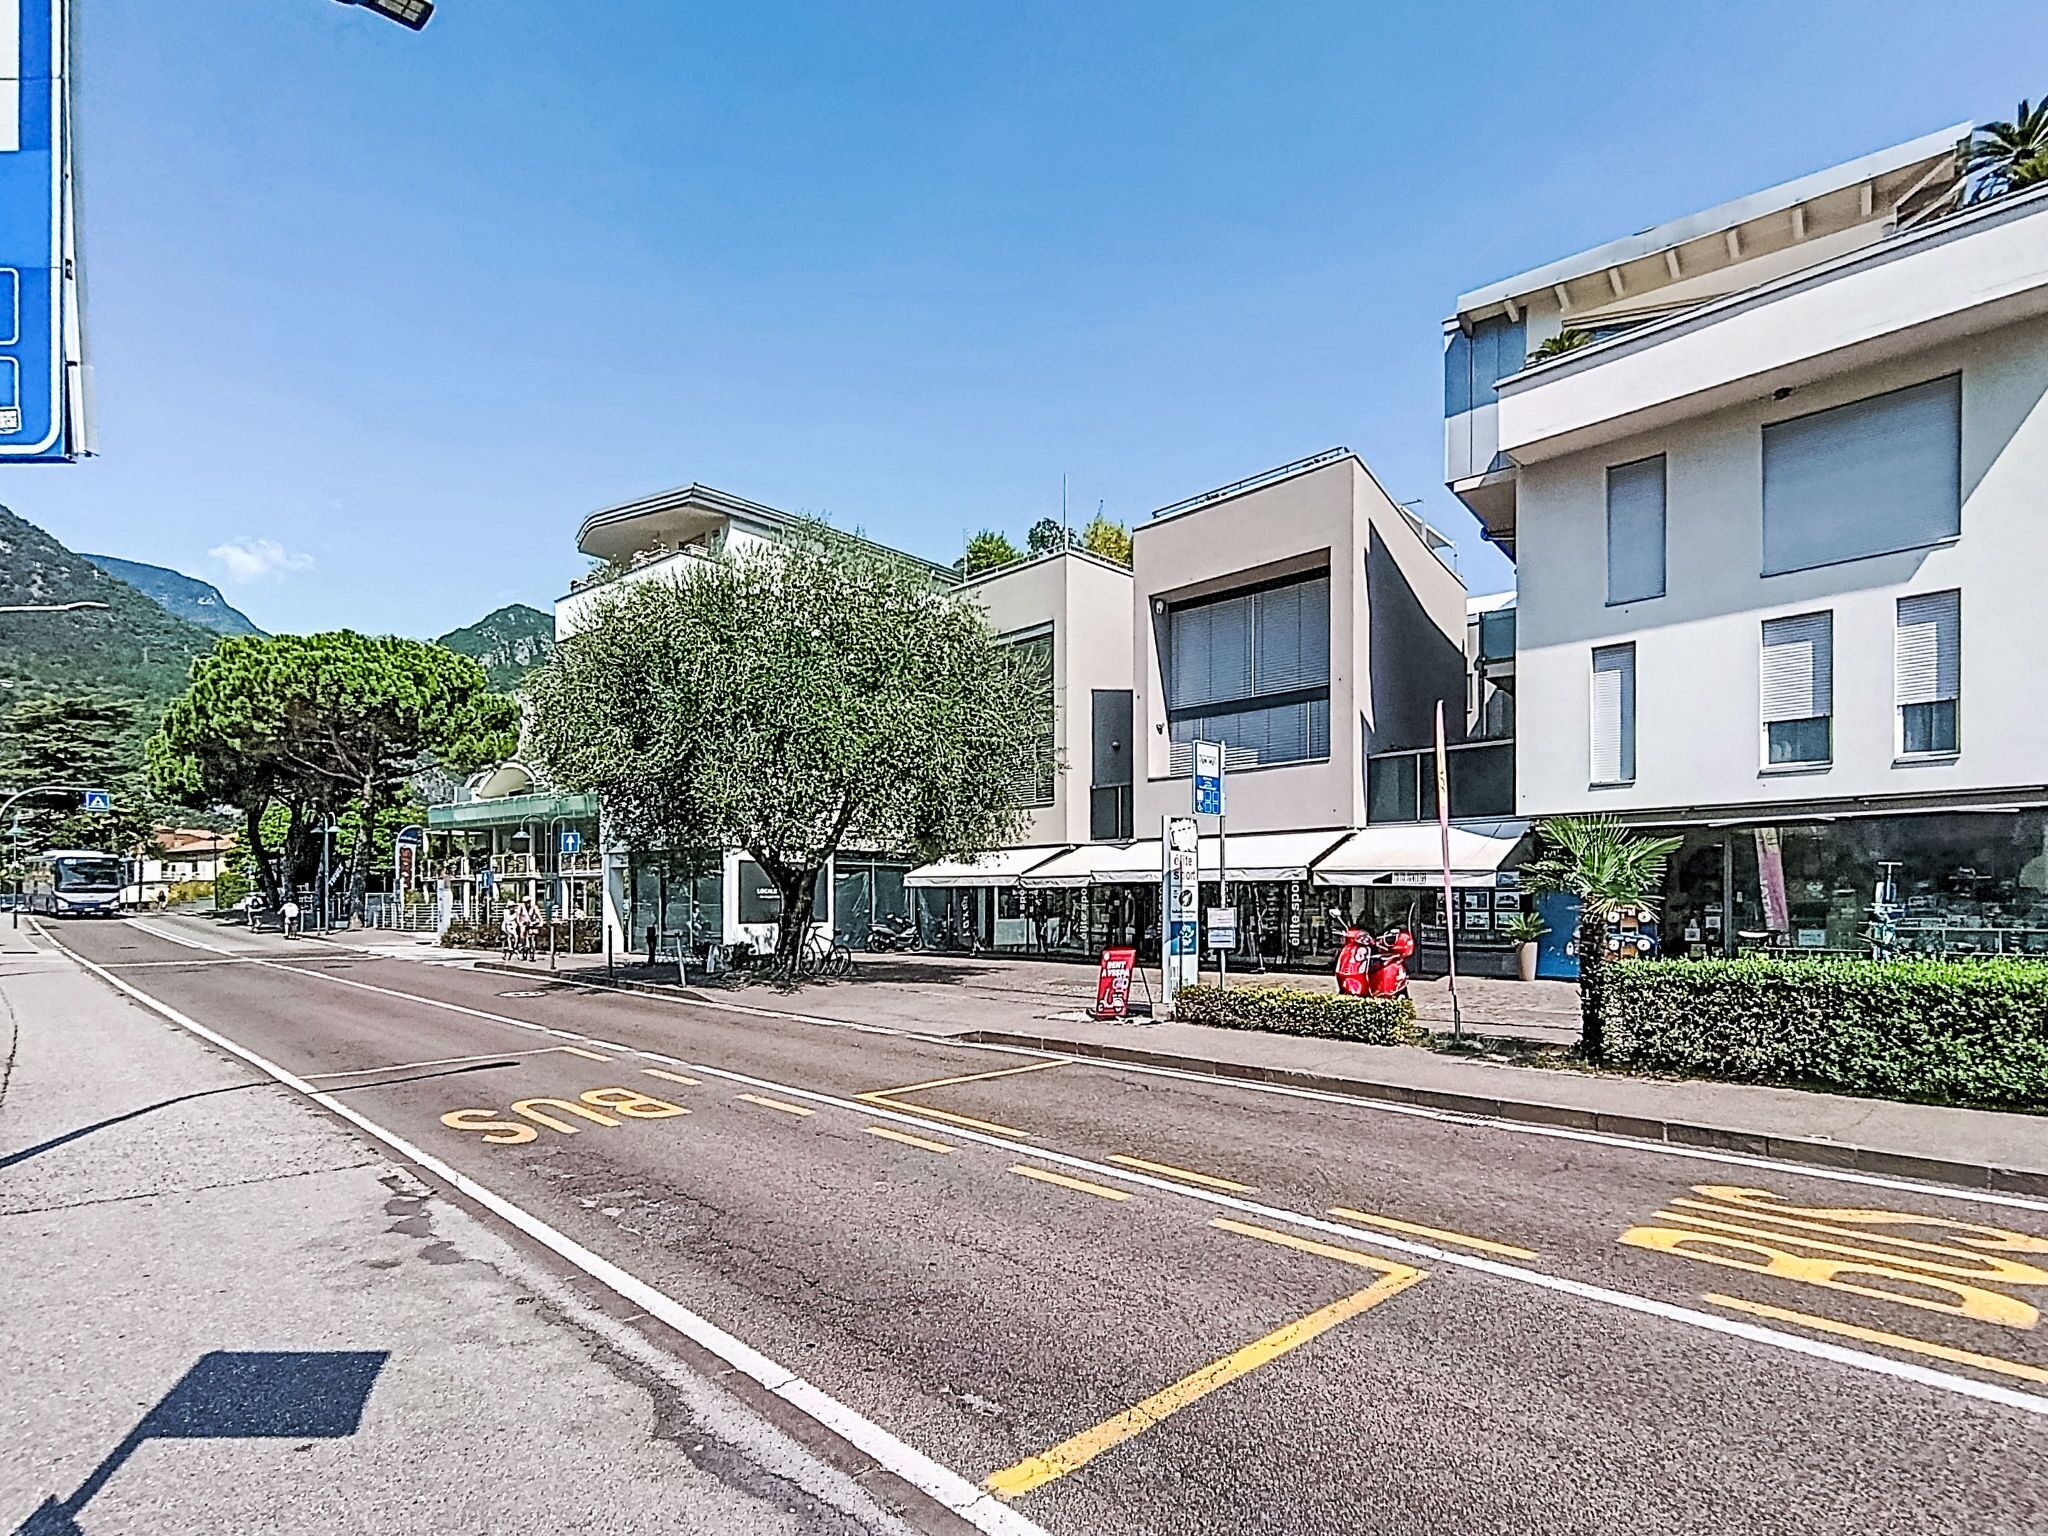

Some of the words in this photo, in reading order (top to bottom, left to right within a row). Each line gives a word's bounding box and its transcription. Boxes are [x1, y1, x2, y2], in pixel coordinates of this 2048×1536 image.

[1288, 914, 1301, 947] élite
[440, 1087, 693, 1145] BUS
[1615, 1184, 2048, 1330] BUS
